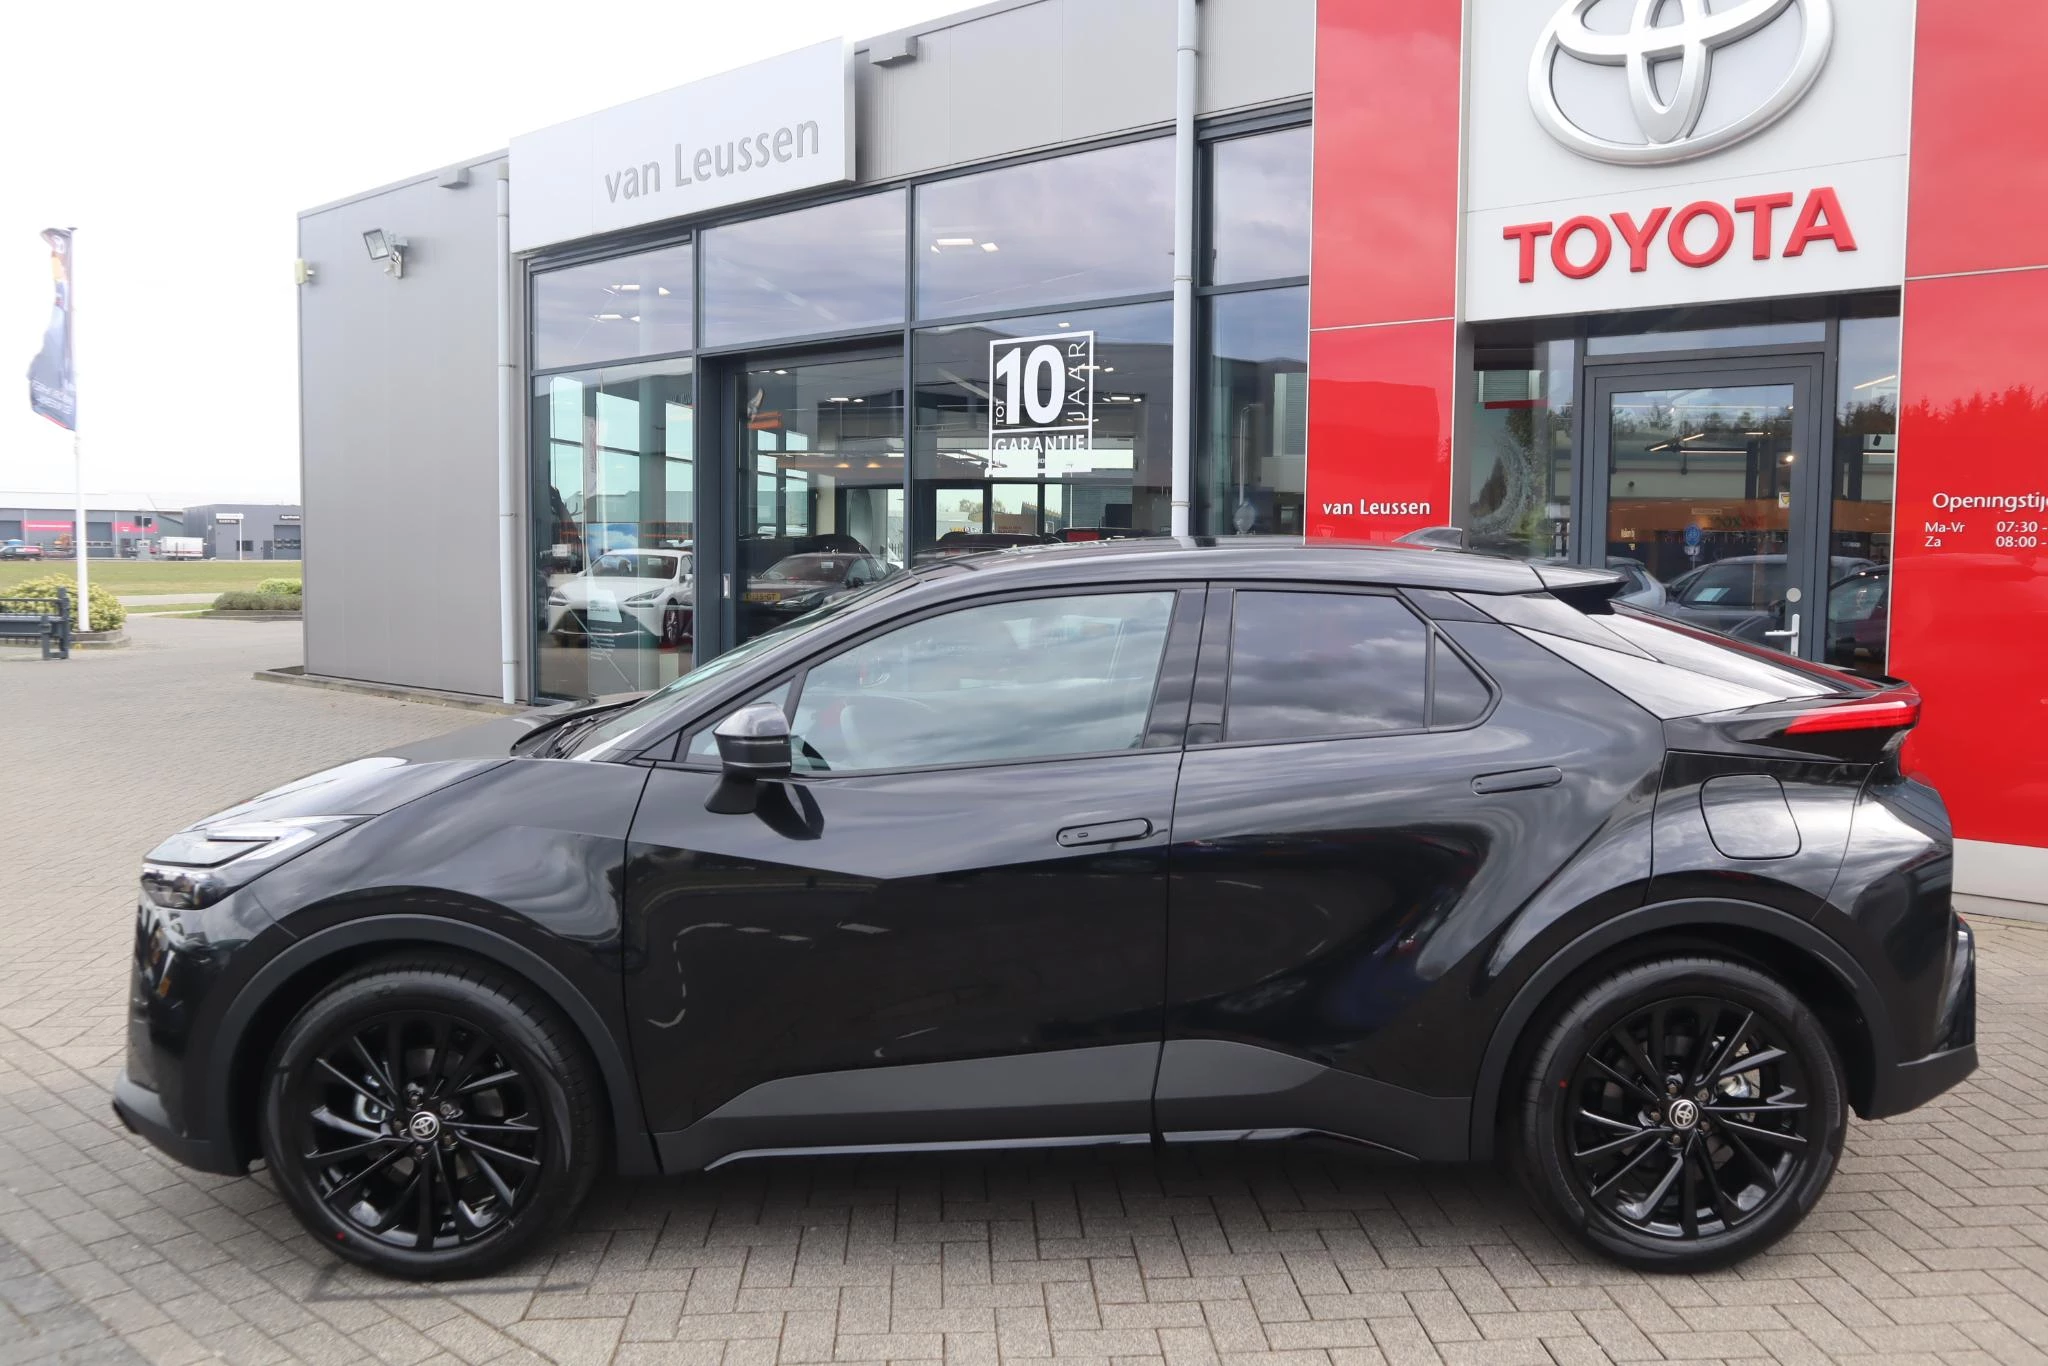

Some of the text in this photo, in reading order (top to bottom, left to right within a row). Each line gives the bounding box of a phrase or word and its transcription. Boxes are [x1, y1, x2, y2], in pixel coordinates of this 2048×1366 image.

[604, 120, 819, 203] van Leussen
[1503, 186, 1858, 283] TOYOTA
[996, 344, 1066, 424] 10
[1068, 340, 1087, 422] JAAR
[995, 399, 1005, 425] TOT
[995, 434, 1085, 452] GARANTIE
[1322, 498, 1431, 515] van Leussen
[1932, 491, 2048, 513] Openingstij
[1925, 521, 1966, 533] Ma-Vr
[1996, 521, 2038, 533] 07:30
[1924, 535, 1942, 547] Za
[1995, 535, 2037, 547] 08:00
